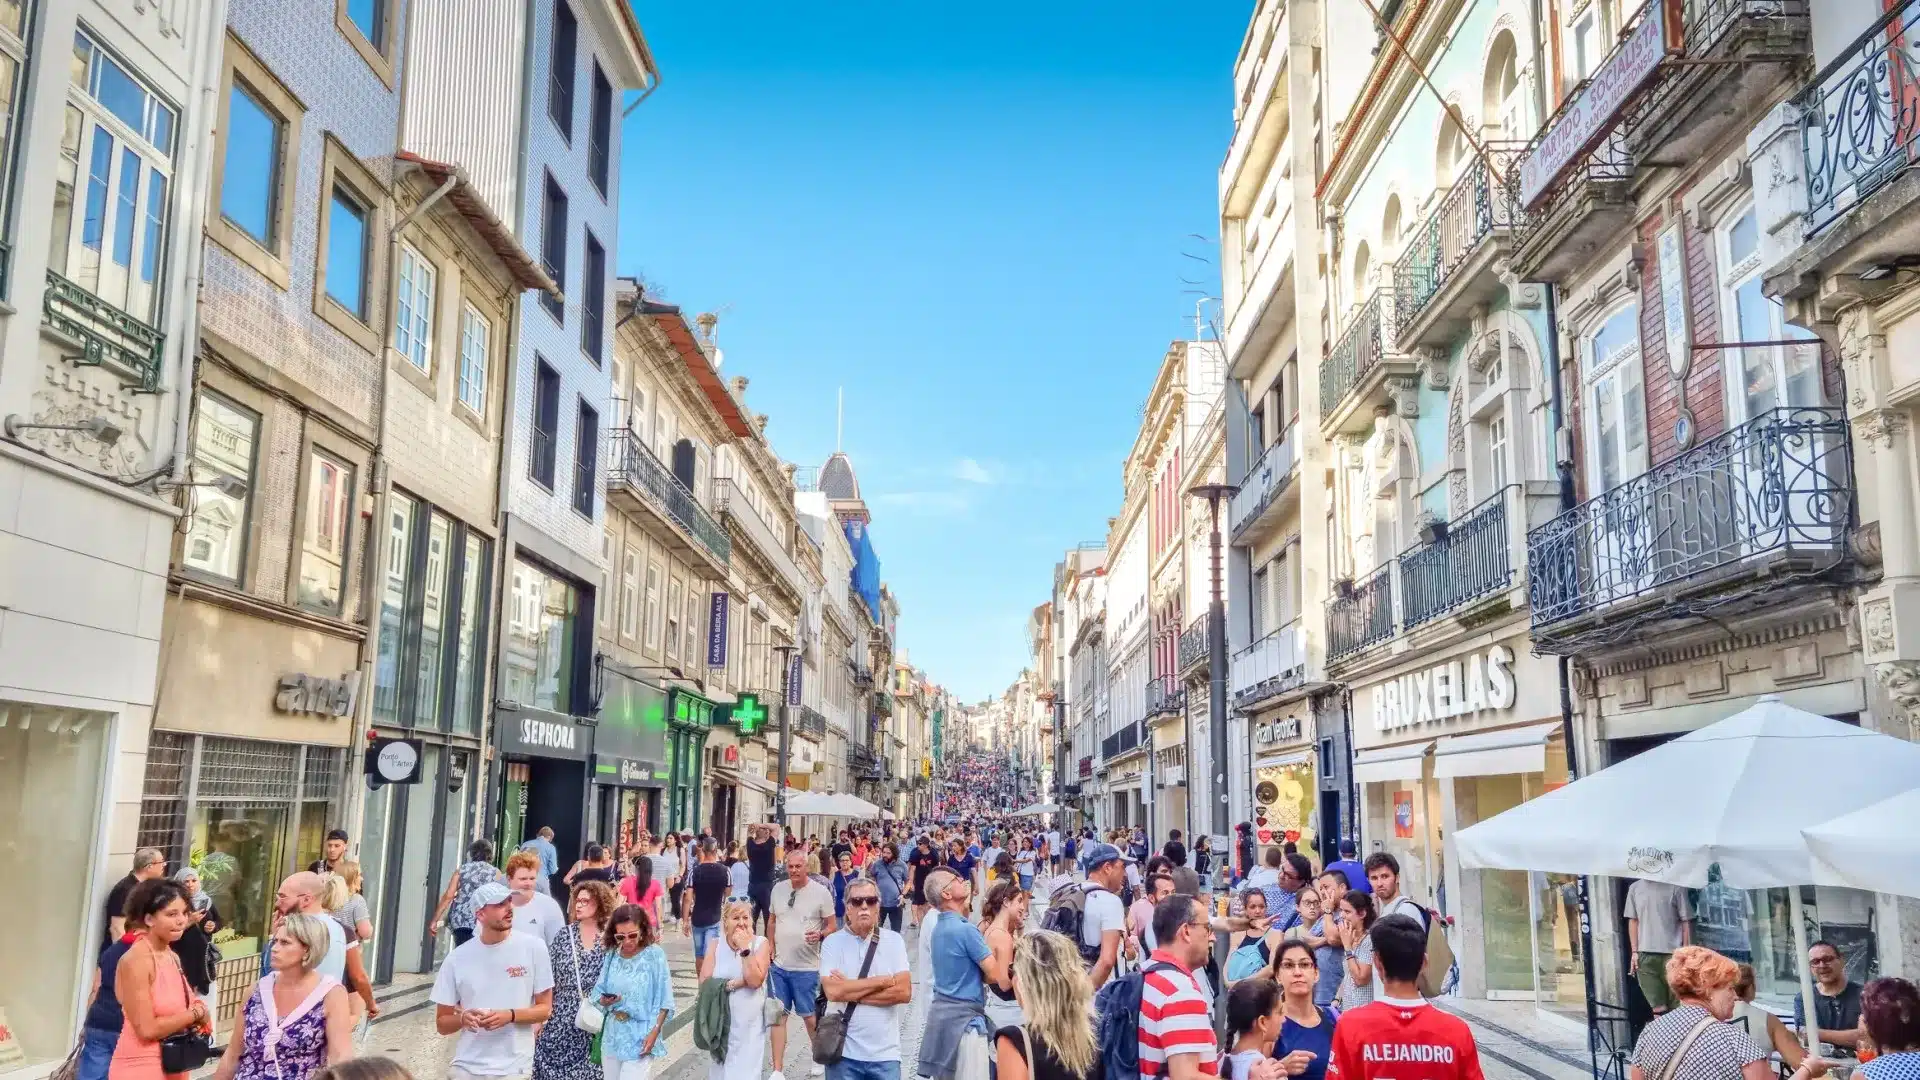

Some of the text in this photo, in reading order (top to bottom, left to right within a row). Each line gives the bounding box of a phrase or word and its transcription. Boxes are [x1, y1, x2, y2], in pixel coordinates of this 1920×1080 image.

[1539, 19, 1659, 167] PARTIDO SOCIALISTA
[1585, 102, 1609, 135] SANTO
[1610, 48, 1655, 104] ILDEFONSO
[715, 595, 723, 612] ALTA
[1372, 645, 1513, 731] BRUXELAS
[520, 719, 575, 750] SEPHORA
[1363, 1043, 1454, 1064] ALEJANDRO
